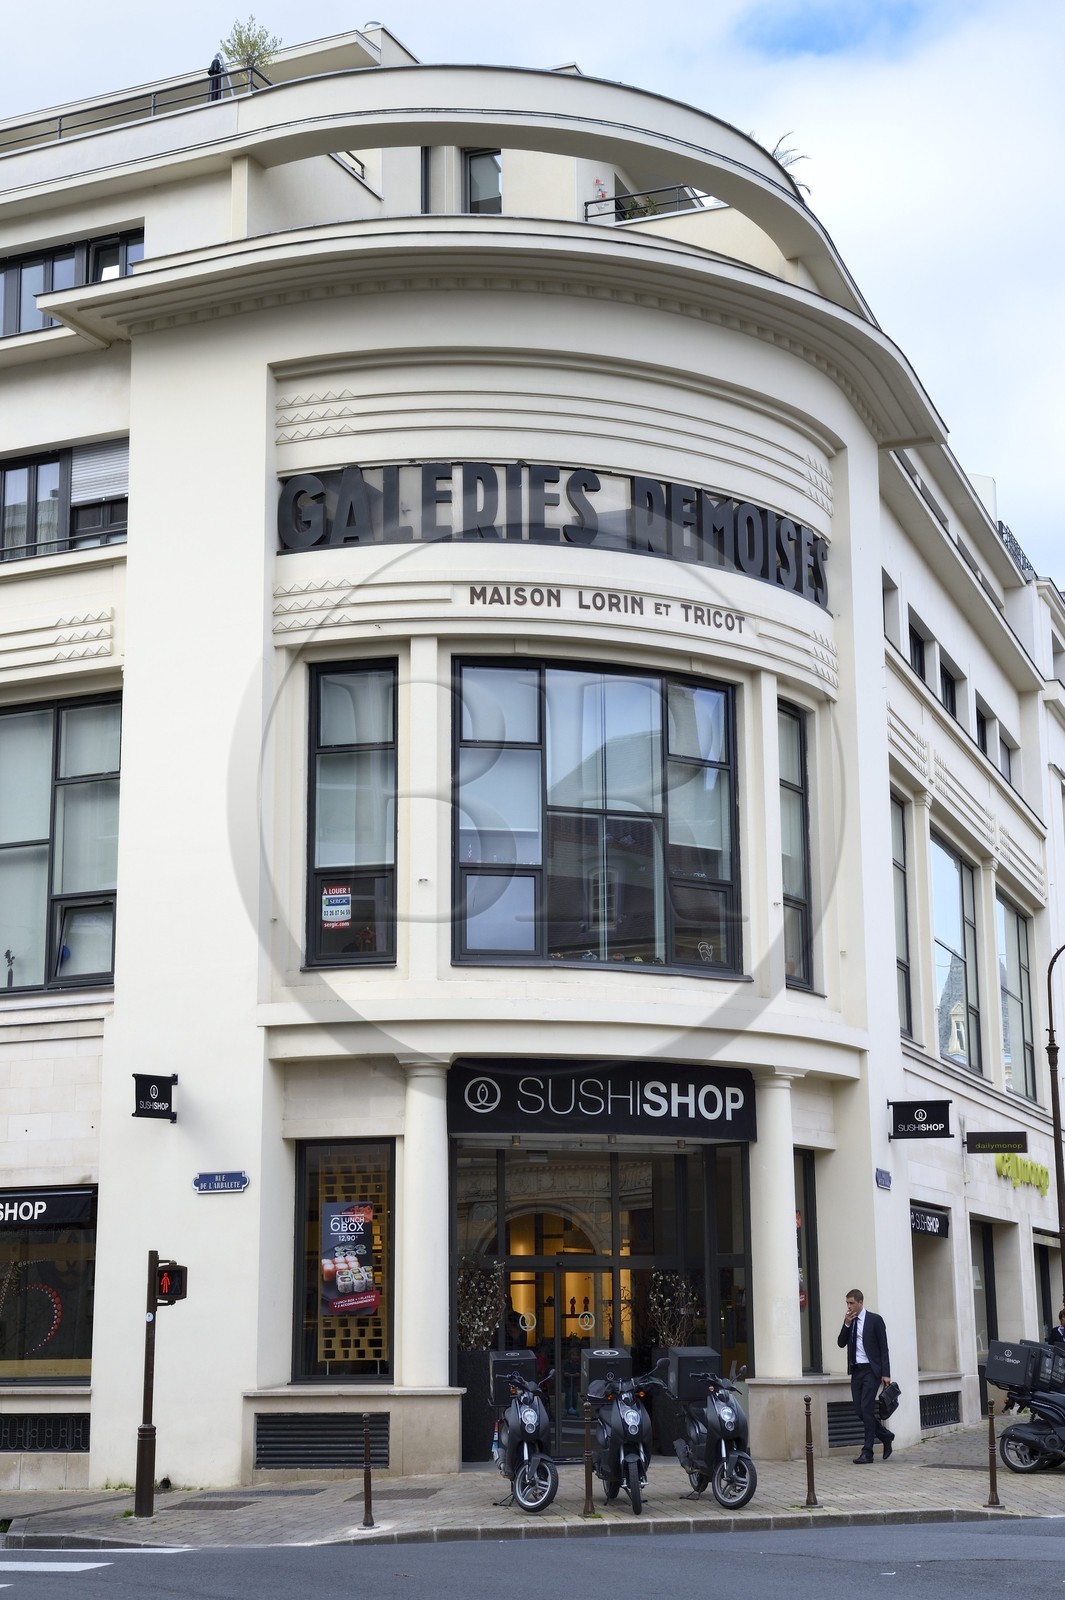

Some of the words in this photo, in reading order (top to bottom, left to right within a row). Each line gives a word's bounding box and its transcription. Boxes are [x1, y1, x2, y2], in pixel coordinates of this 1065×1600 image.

[278, 463, 602, 549] GALERIES
[632, 476, 829, 611] REMOISES
[469, 586, 561, 608] MAISON
[578, 590, 644, 615] LORIN
[654, 602, 672, 616] ET
[680, 603, 746, 634] TRICOT
[329, 887, 347, 895] LOUER
[517, 1076, 744, 1121] SUSHISHOP
[975, 1142, 1023, 1150] dailymonop
[330, 1217, 340, 1232] 6
[340, 1222, 364, 1232] BOX
